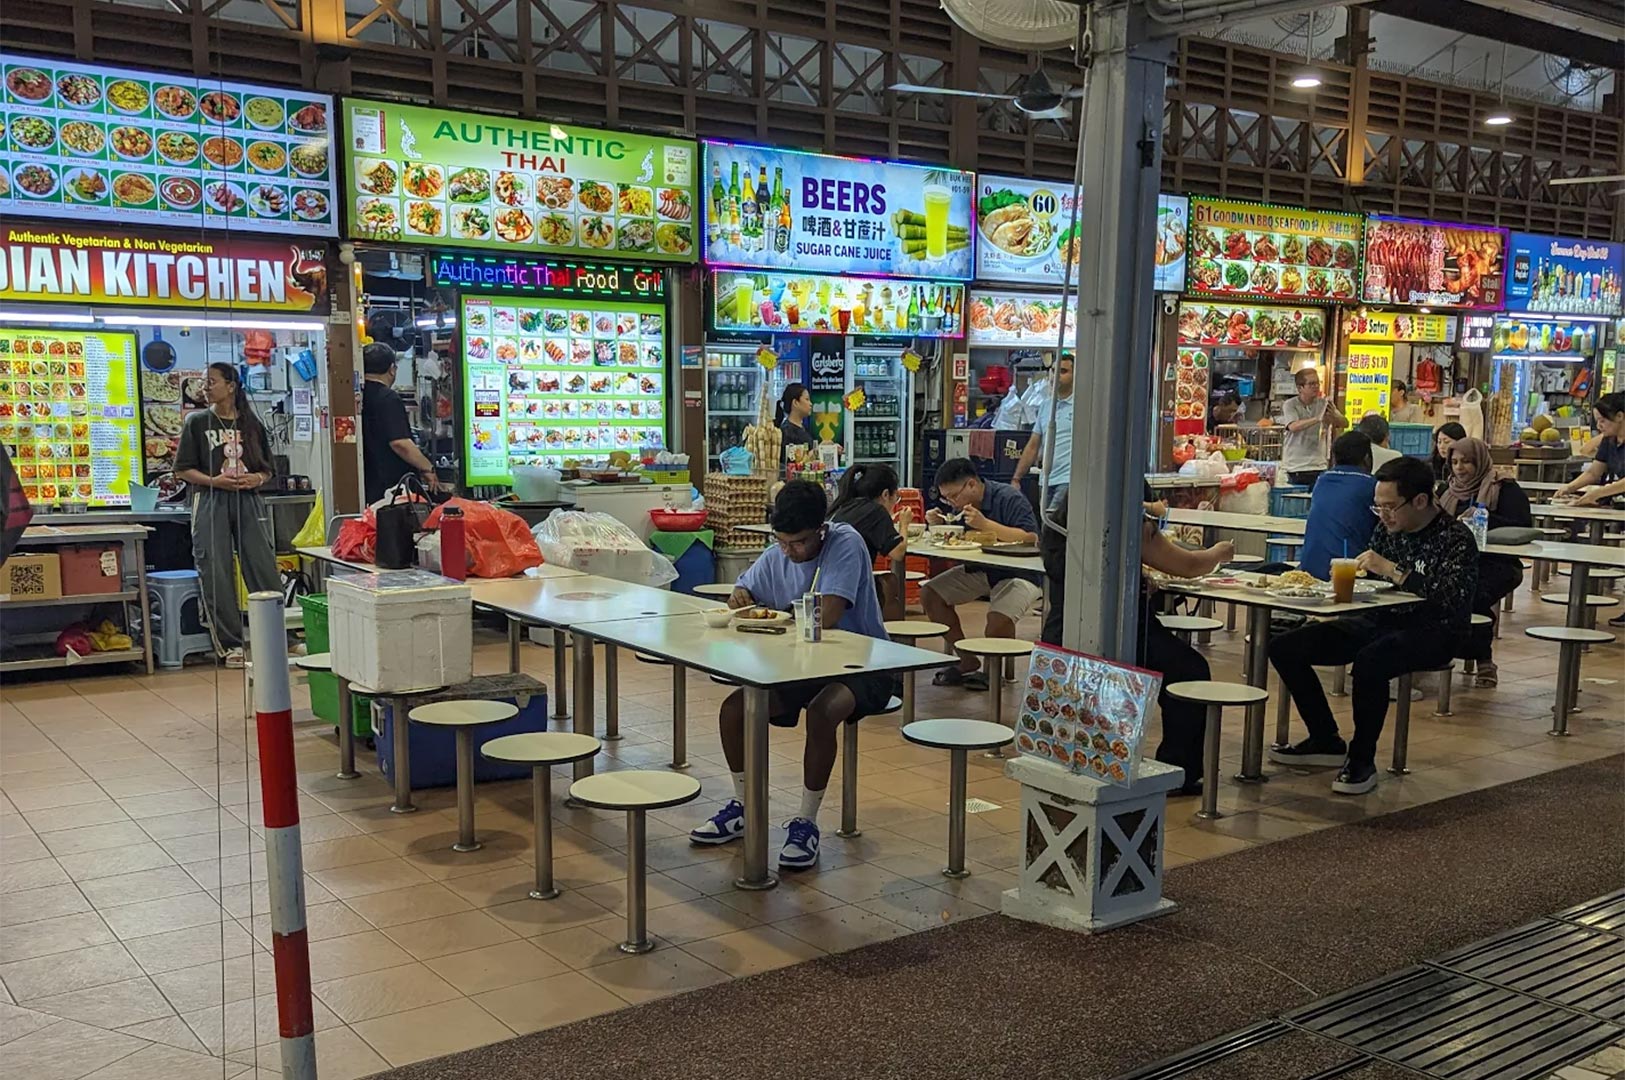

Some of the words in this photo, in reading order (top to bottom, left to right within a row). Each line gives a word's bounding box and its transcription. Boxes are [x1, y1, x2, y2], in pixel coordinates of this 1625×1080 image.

[433, 120, 626, 160] AUTHENTIC
[501, 151, 567, 174] THAI
[802, 176, 887, 216] BEERS
[1032, 194, 1056, 214] 60
[802, 216, 886, 242] 啤酒&甘蔗汁
[1196, 204, 1212, 224] 61
[1213, 210, 1256, 225] GOODMAN
[1257, 214, 1274, 226] BBQ
[1275, 215, 1311, 230] SEAFOOD
[8, 230, 60, 245] Authentic
[62, 233, 121, 250] Vegetarian
[124, 239, 131, 250] &
[134, 239, 156, 251] Non
[158, 240, 214, 254] Vegetarian
[796, 242, 831, 257] SUGAR
[834, 246, 861, 259] CANE
[863, 247, 891, 261] JUICE
[102, 250, 287, 304] KITCHEN
[438, 260, 527, 286] Authentic
[577, 269, 619, 290] Food
[1369, 319, 1388, 336] Satay
[812, 352, 844, 373] Carlsberg
[1350, 373, 1373, 384] Chicken
[1374, 374, 1388, 385] Wing
